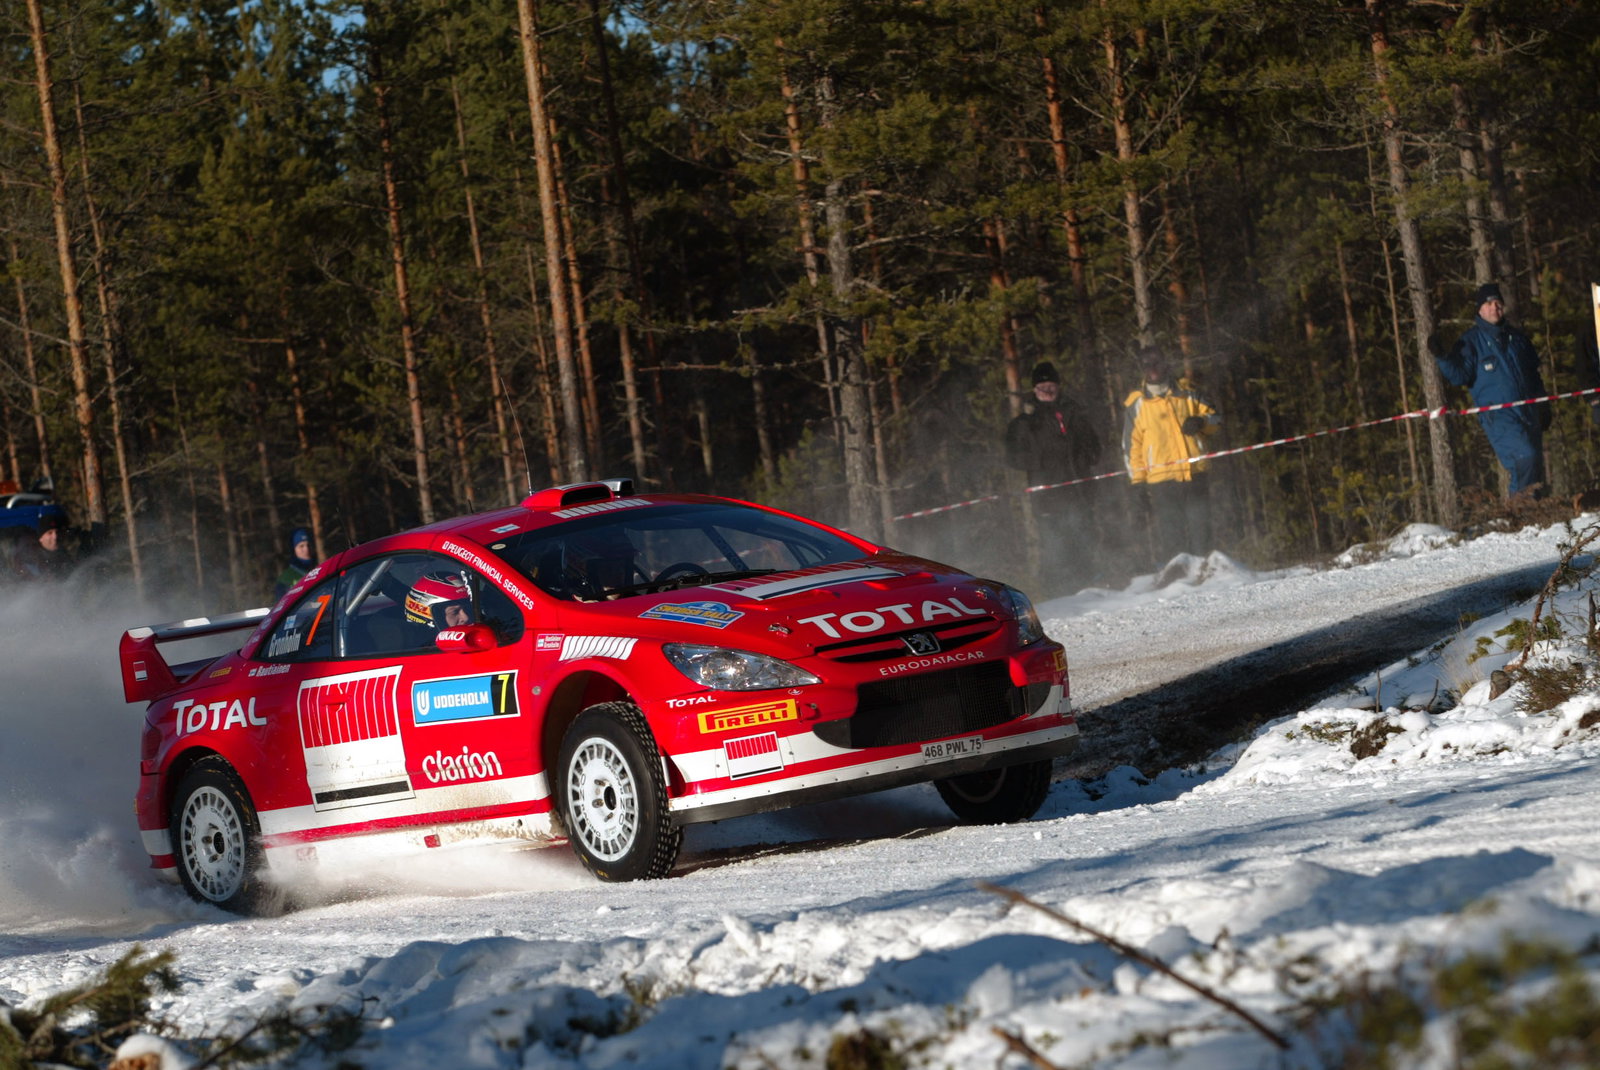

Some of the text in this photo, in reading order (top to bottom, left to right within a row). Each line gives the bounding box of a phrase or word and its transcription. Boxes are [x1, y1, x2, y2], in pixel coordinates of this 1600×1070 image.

[447, 542, 475, 563] PEUGEOT
[472, 555, 504, 584] FINANCIAL
[502, 578, 535, 611] SERVICES
[305, 594, 332, 646] 7
[797, 597, 987, 639] TOTAL
[879, 650, 985, 676] EURODATACAR
[433, 674, 510, 714] UDDEHOLM 7
[666, 695, 717, 709] TOTAL
[172, 696, 267, 737] TOTAL
[705, 702, 788, 731] PIRELLI
[422, 745, 503, 783] clarion
[925, 738, 981, 758] 468 PWL 75
